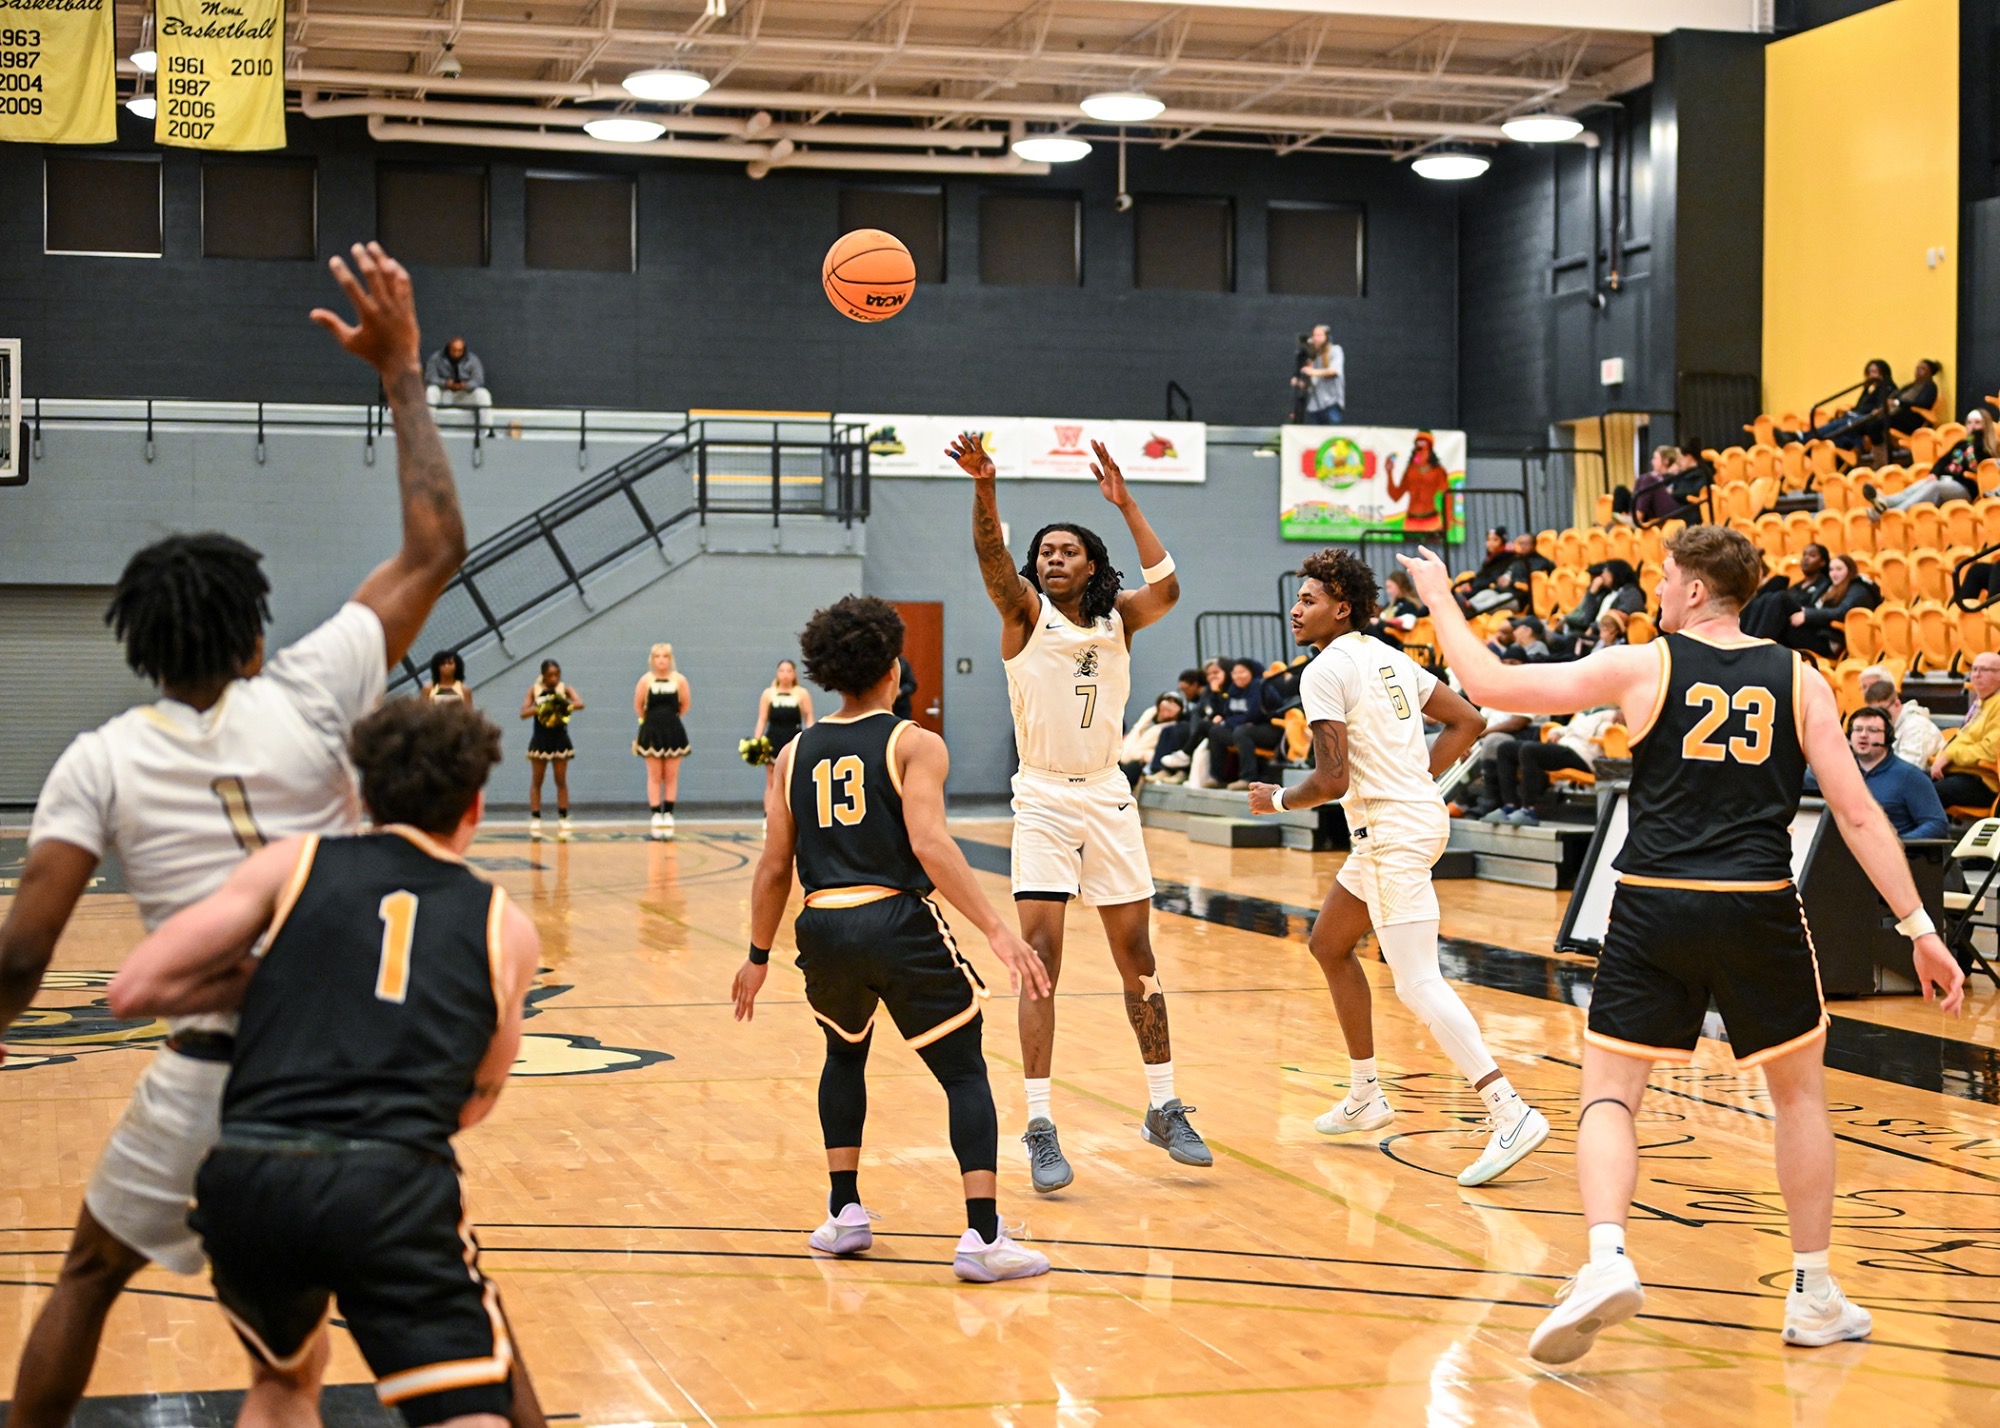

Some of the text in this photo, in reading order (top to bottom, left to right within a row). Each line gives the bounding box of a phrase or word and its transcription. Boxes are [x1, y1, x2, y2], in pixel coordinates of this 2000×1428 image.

[201, 1, 244, 16] Mens
[162, 16, 277, 39] Basketball
[168, 56, 273, 77] 1961 2010
[0, 73, 43, 93] 2004
[168, 78, 210, 97] 1987
[0, 97, 43, 115] 2009
[168, 98, 216, 119] 2006
[168, 120, 215, 140] 2007
[865, 293, 907, 307] NCAA
[1378, 665, 1411, 720] 6
[1075, 684, 1097, 728] 7
[1681, 681, 1777, 766] 23
[812, 754, 867, 828] 13
[210, 775, 268, 857] 1
[374, 889, 420, 1005] 1
